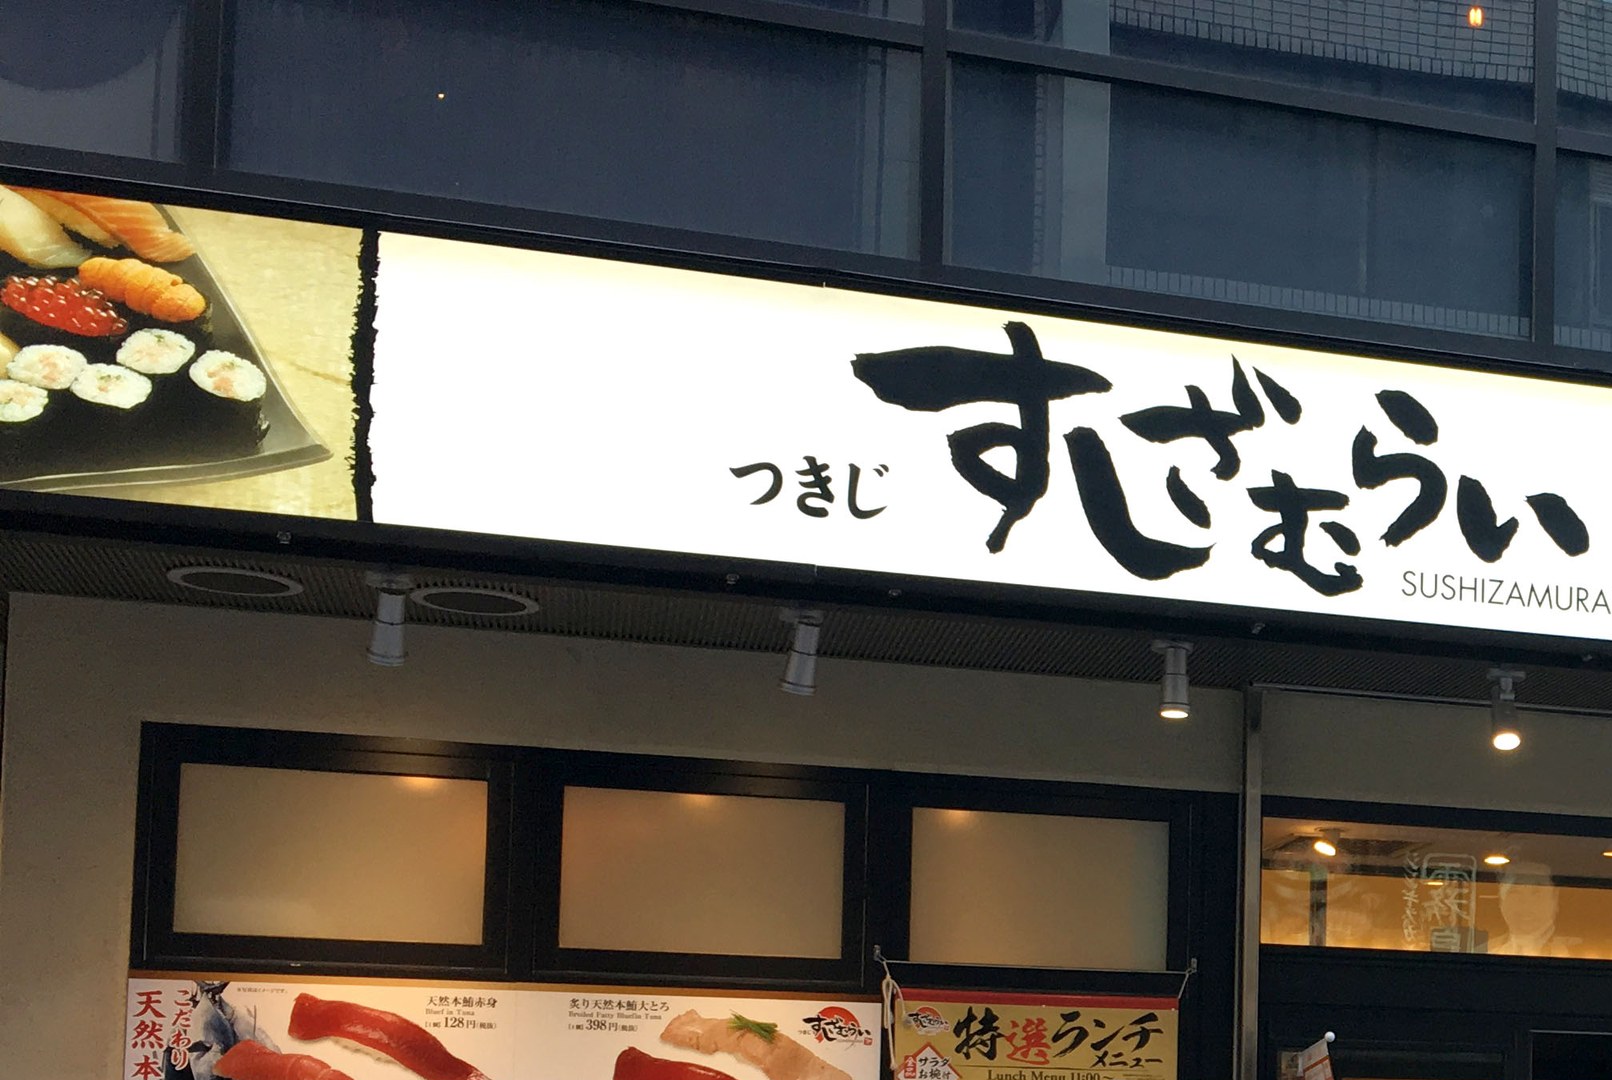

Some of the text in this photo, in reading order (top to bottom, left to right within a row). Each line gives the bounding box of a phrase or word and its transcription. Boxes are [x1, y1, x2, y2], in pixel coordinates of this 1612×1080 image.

[729, 458, 890, 520] つきじ
[852, 320, 1590, 596] すしざむらい
[171, 989, 193, 1071] こだわり
